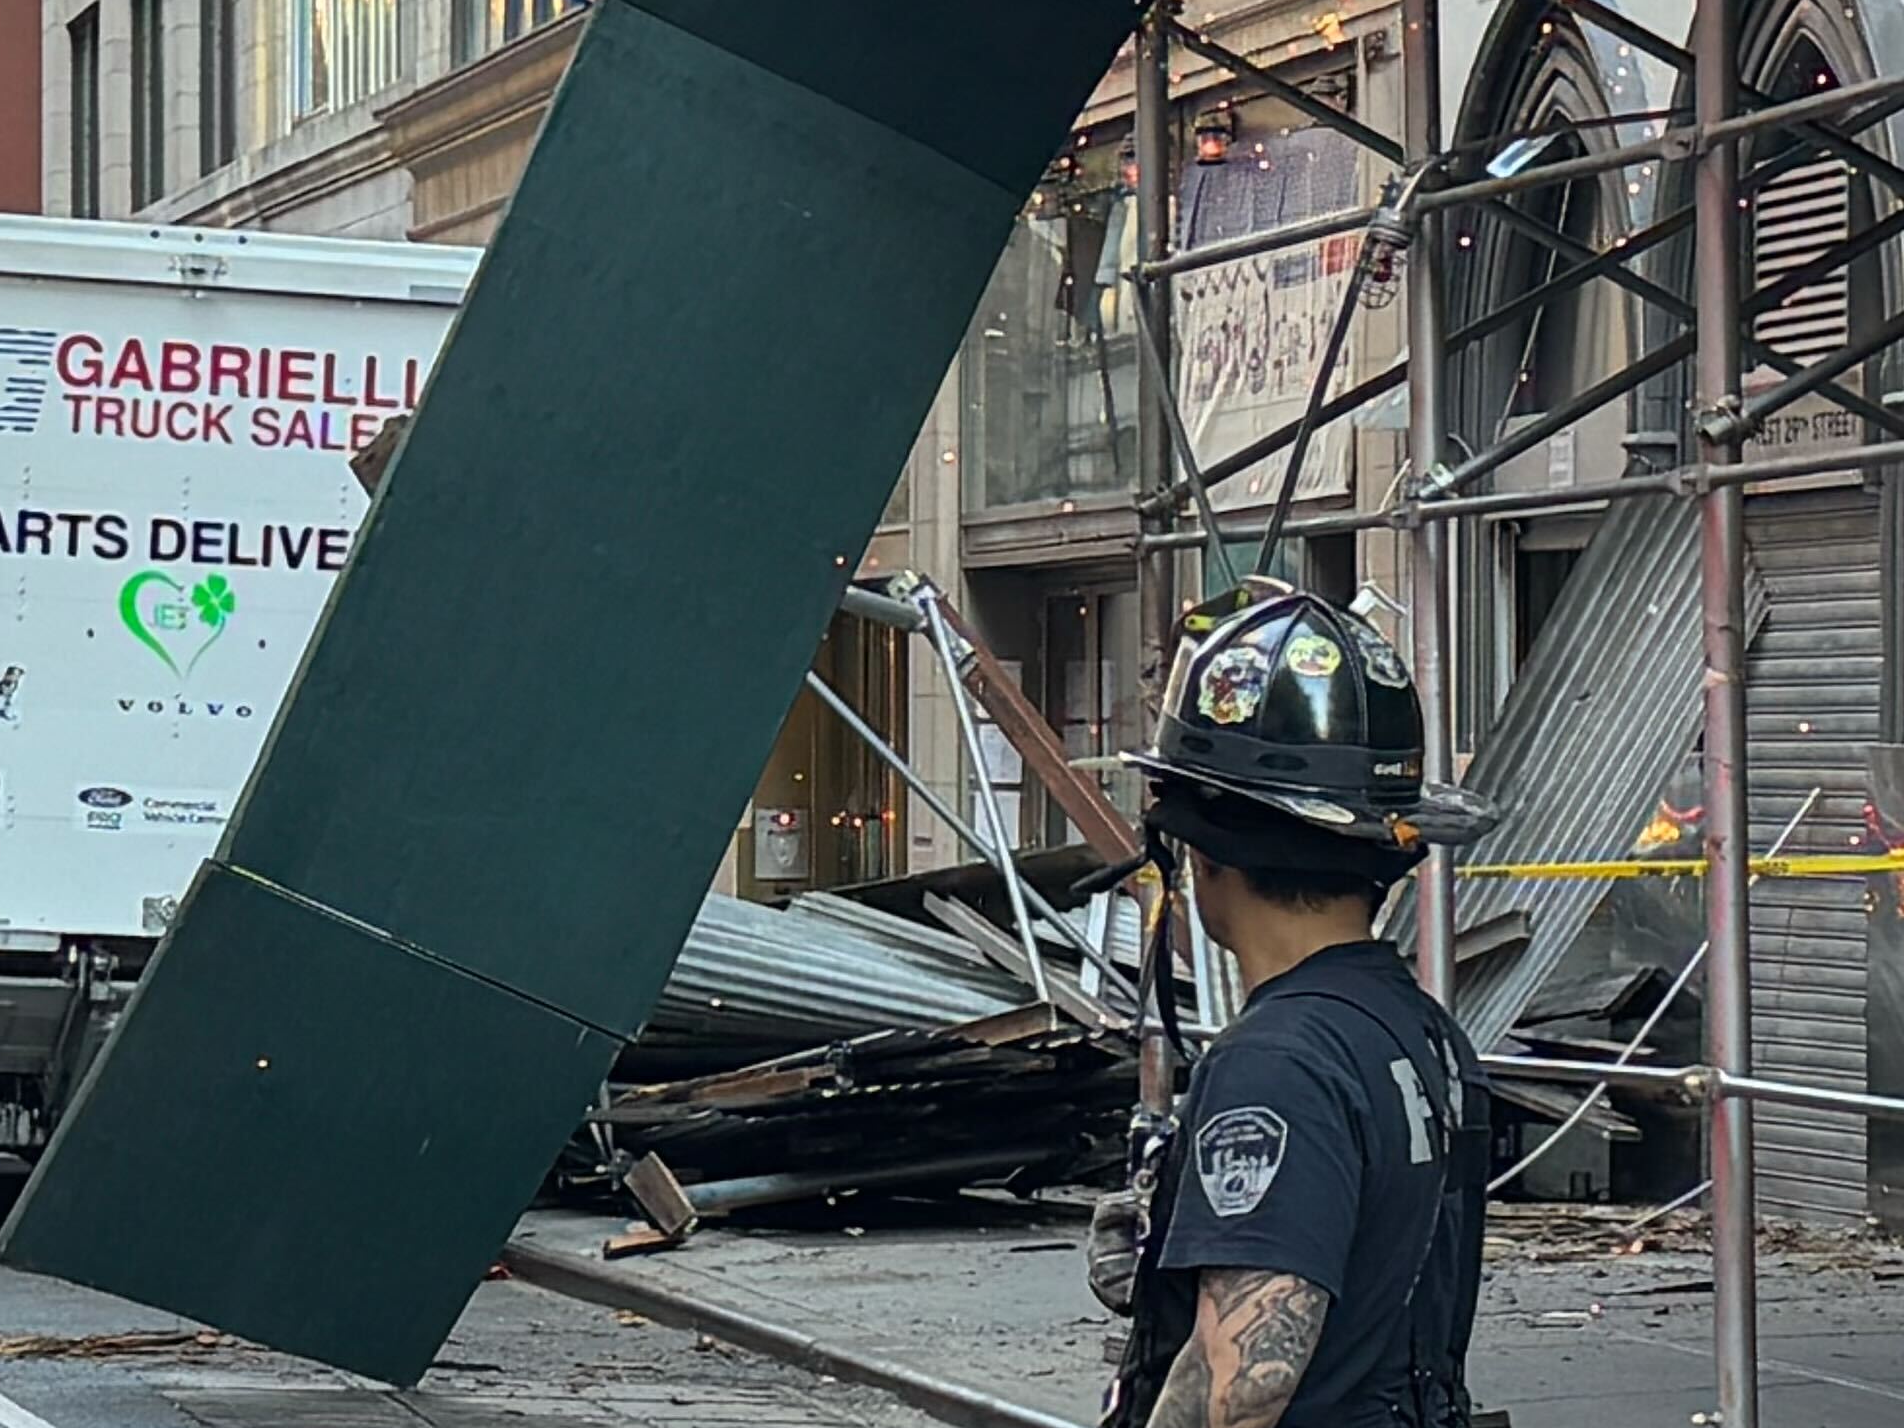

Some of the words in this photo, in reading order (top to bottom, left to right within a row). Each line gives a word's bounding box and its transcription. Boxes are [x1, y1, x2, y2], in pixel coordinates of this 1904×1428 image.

[56, 334, 418, 410] GABRIELLI
[62, 393, 234, 445] TRUCK
[251, 407, 381, 452] SALE
[149, 518, 352, 571] DELIVE
[117, 698, 254, 719] VOLVO
